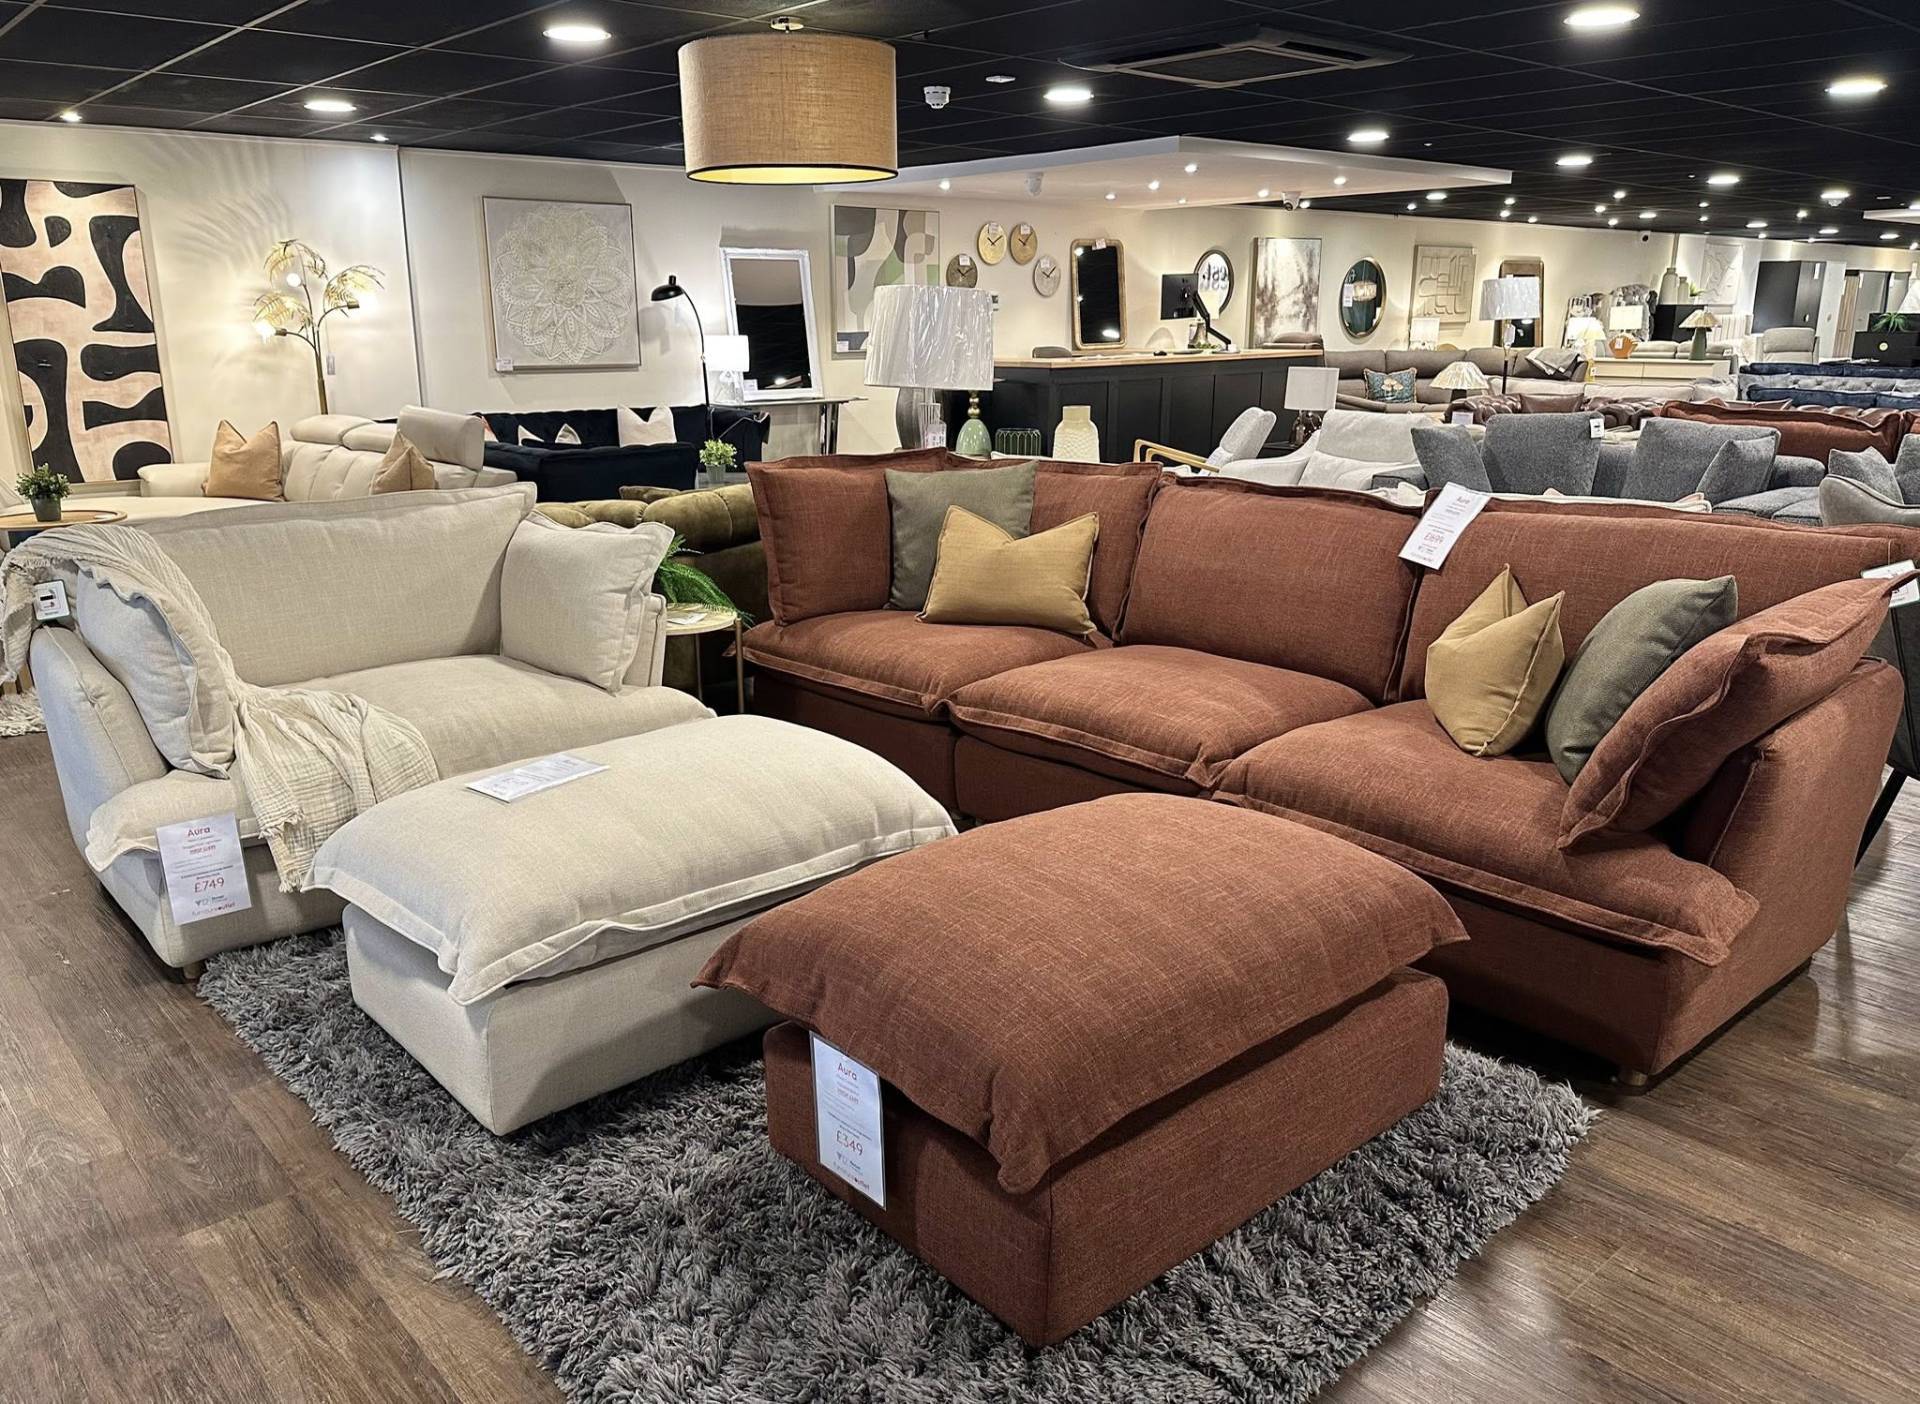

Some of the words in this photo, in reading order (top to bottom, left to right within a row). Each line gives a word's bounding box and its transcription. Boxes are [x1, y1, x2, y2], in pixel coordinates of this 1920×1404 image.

[187, 826, 211, 837] Aura
[194, 877, 225, 893] £749
[838, 1062, 857, 1080] Aura
[836, 1130, 863, 1155] £349
